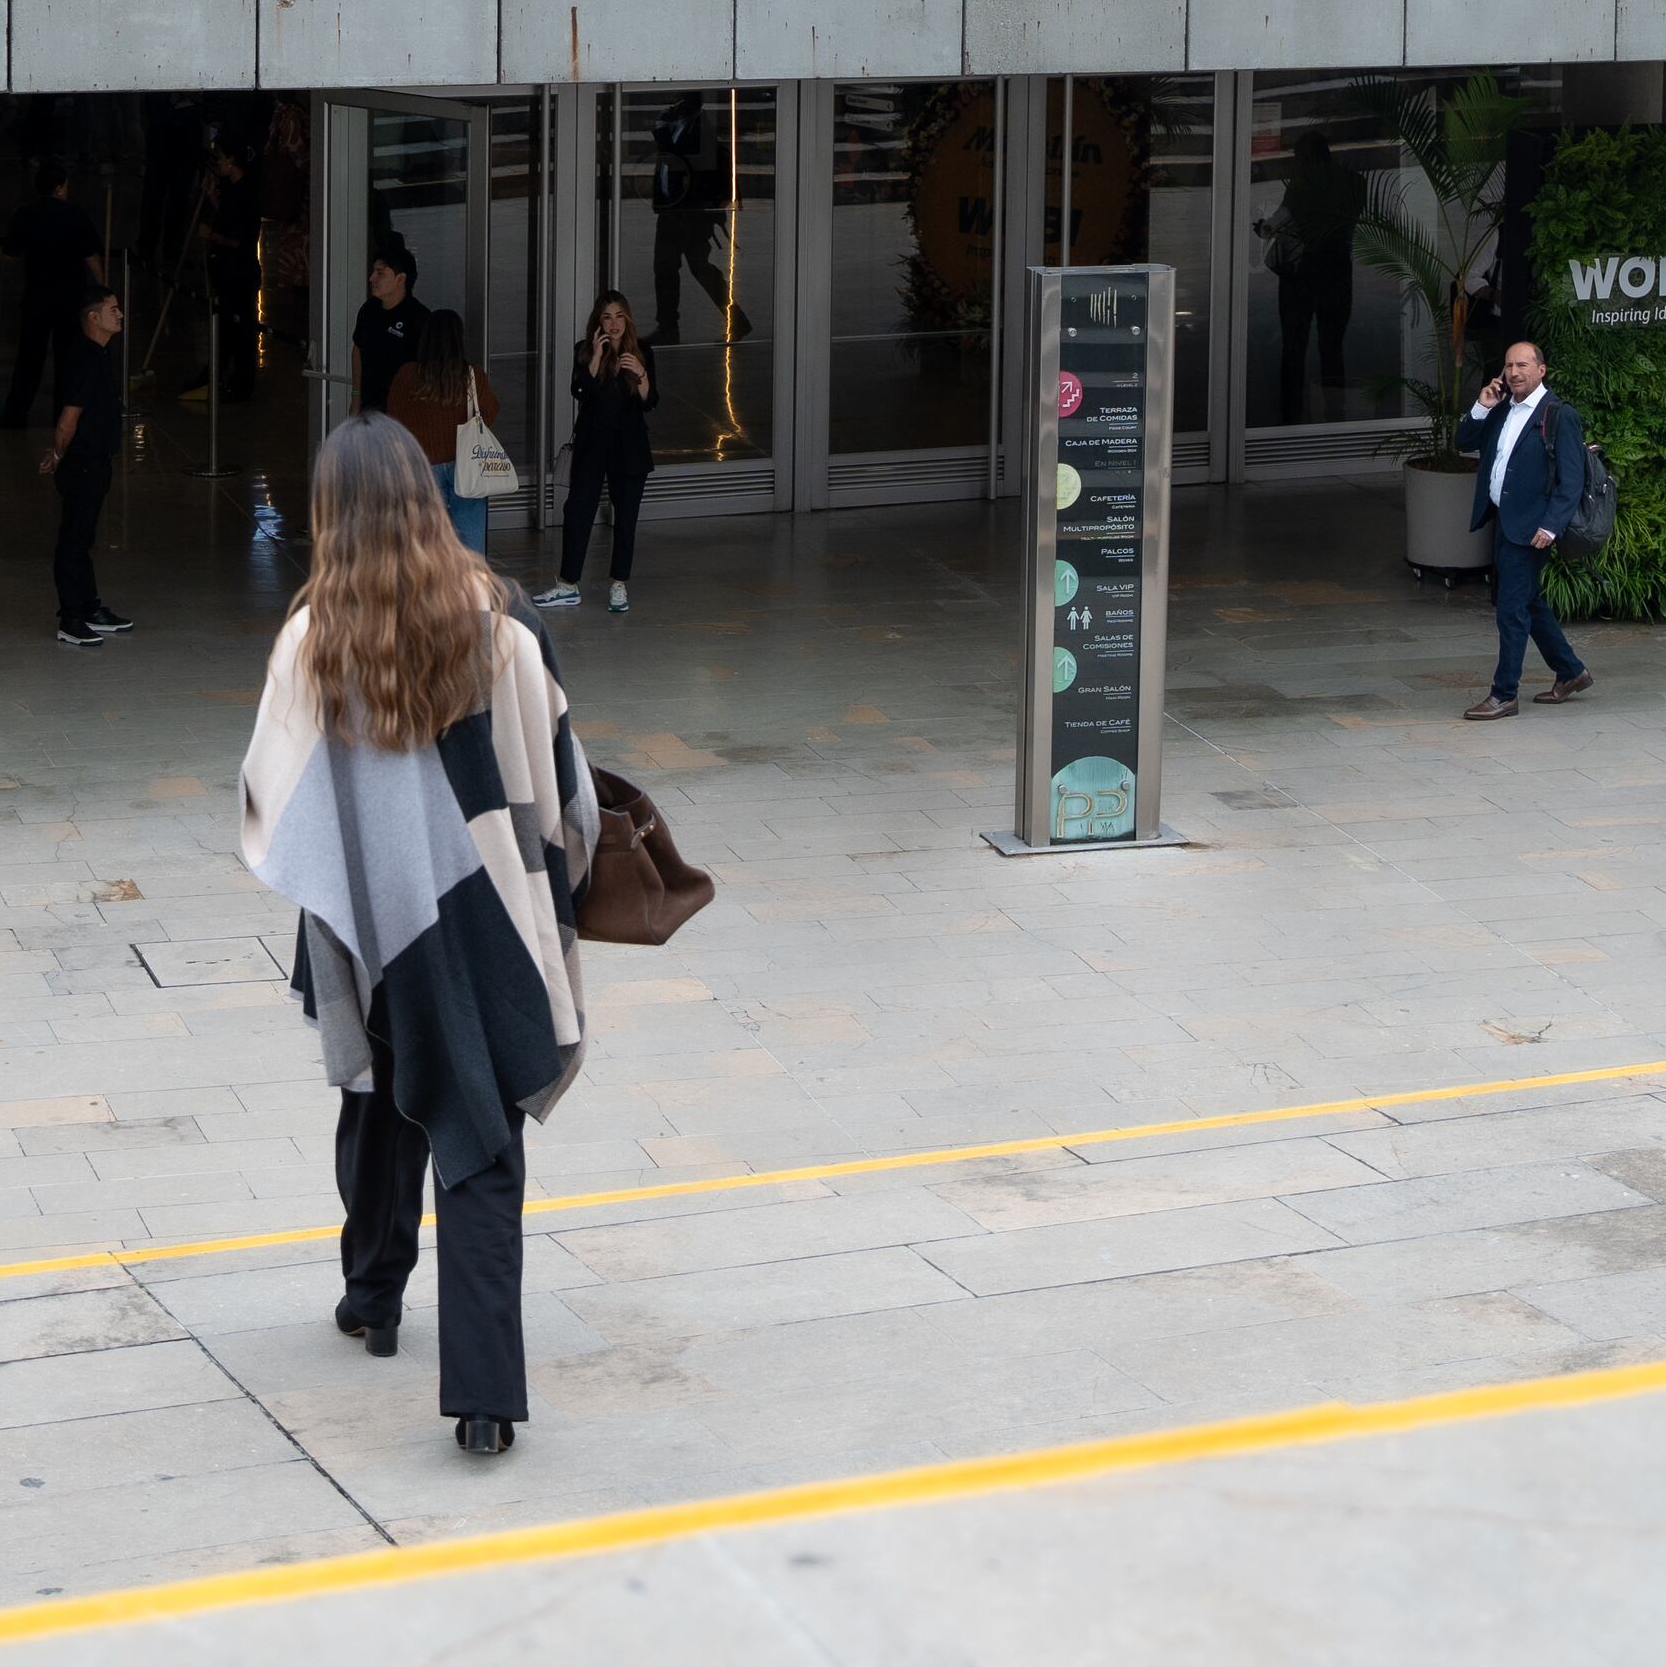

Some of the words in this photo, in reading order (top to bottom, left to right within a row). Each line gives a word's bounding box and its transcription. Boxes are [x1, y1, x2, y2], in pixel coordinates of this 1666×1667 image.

[1591, 308, 1651, 326] Inspiring
[1099, 414, 1138, 422] COMIDAS
[1065, 439, 1088, 447] CAJA
[1089, 438, 1100, 446] DE
[1090, 494, 1136, 502] CAFETERÍA
[1106, 515, 1135, 523] SALÓN
[1063, 523, 1135, 533] MULTIPROPÓSITO
[1101, 547, 1134, 555] PALCOS
[1096, 584, 1118, 592] SALA
[1105, 608, 1134, 616] BAÑOS
[1094, 634, 1121, 642] SALAS
[1082, 642, 1134, 650] COMISIONES
[1103, 684, 1132, 692] SALÓN
[1065, 721, 1094, 729] TIENDA
[1108, 717, 1132, 725] CAFÉ
